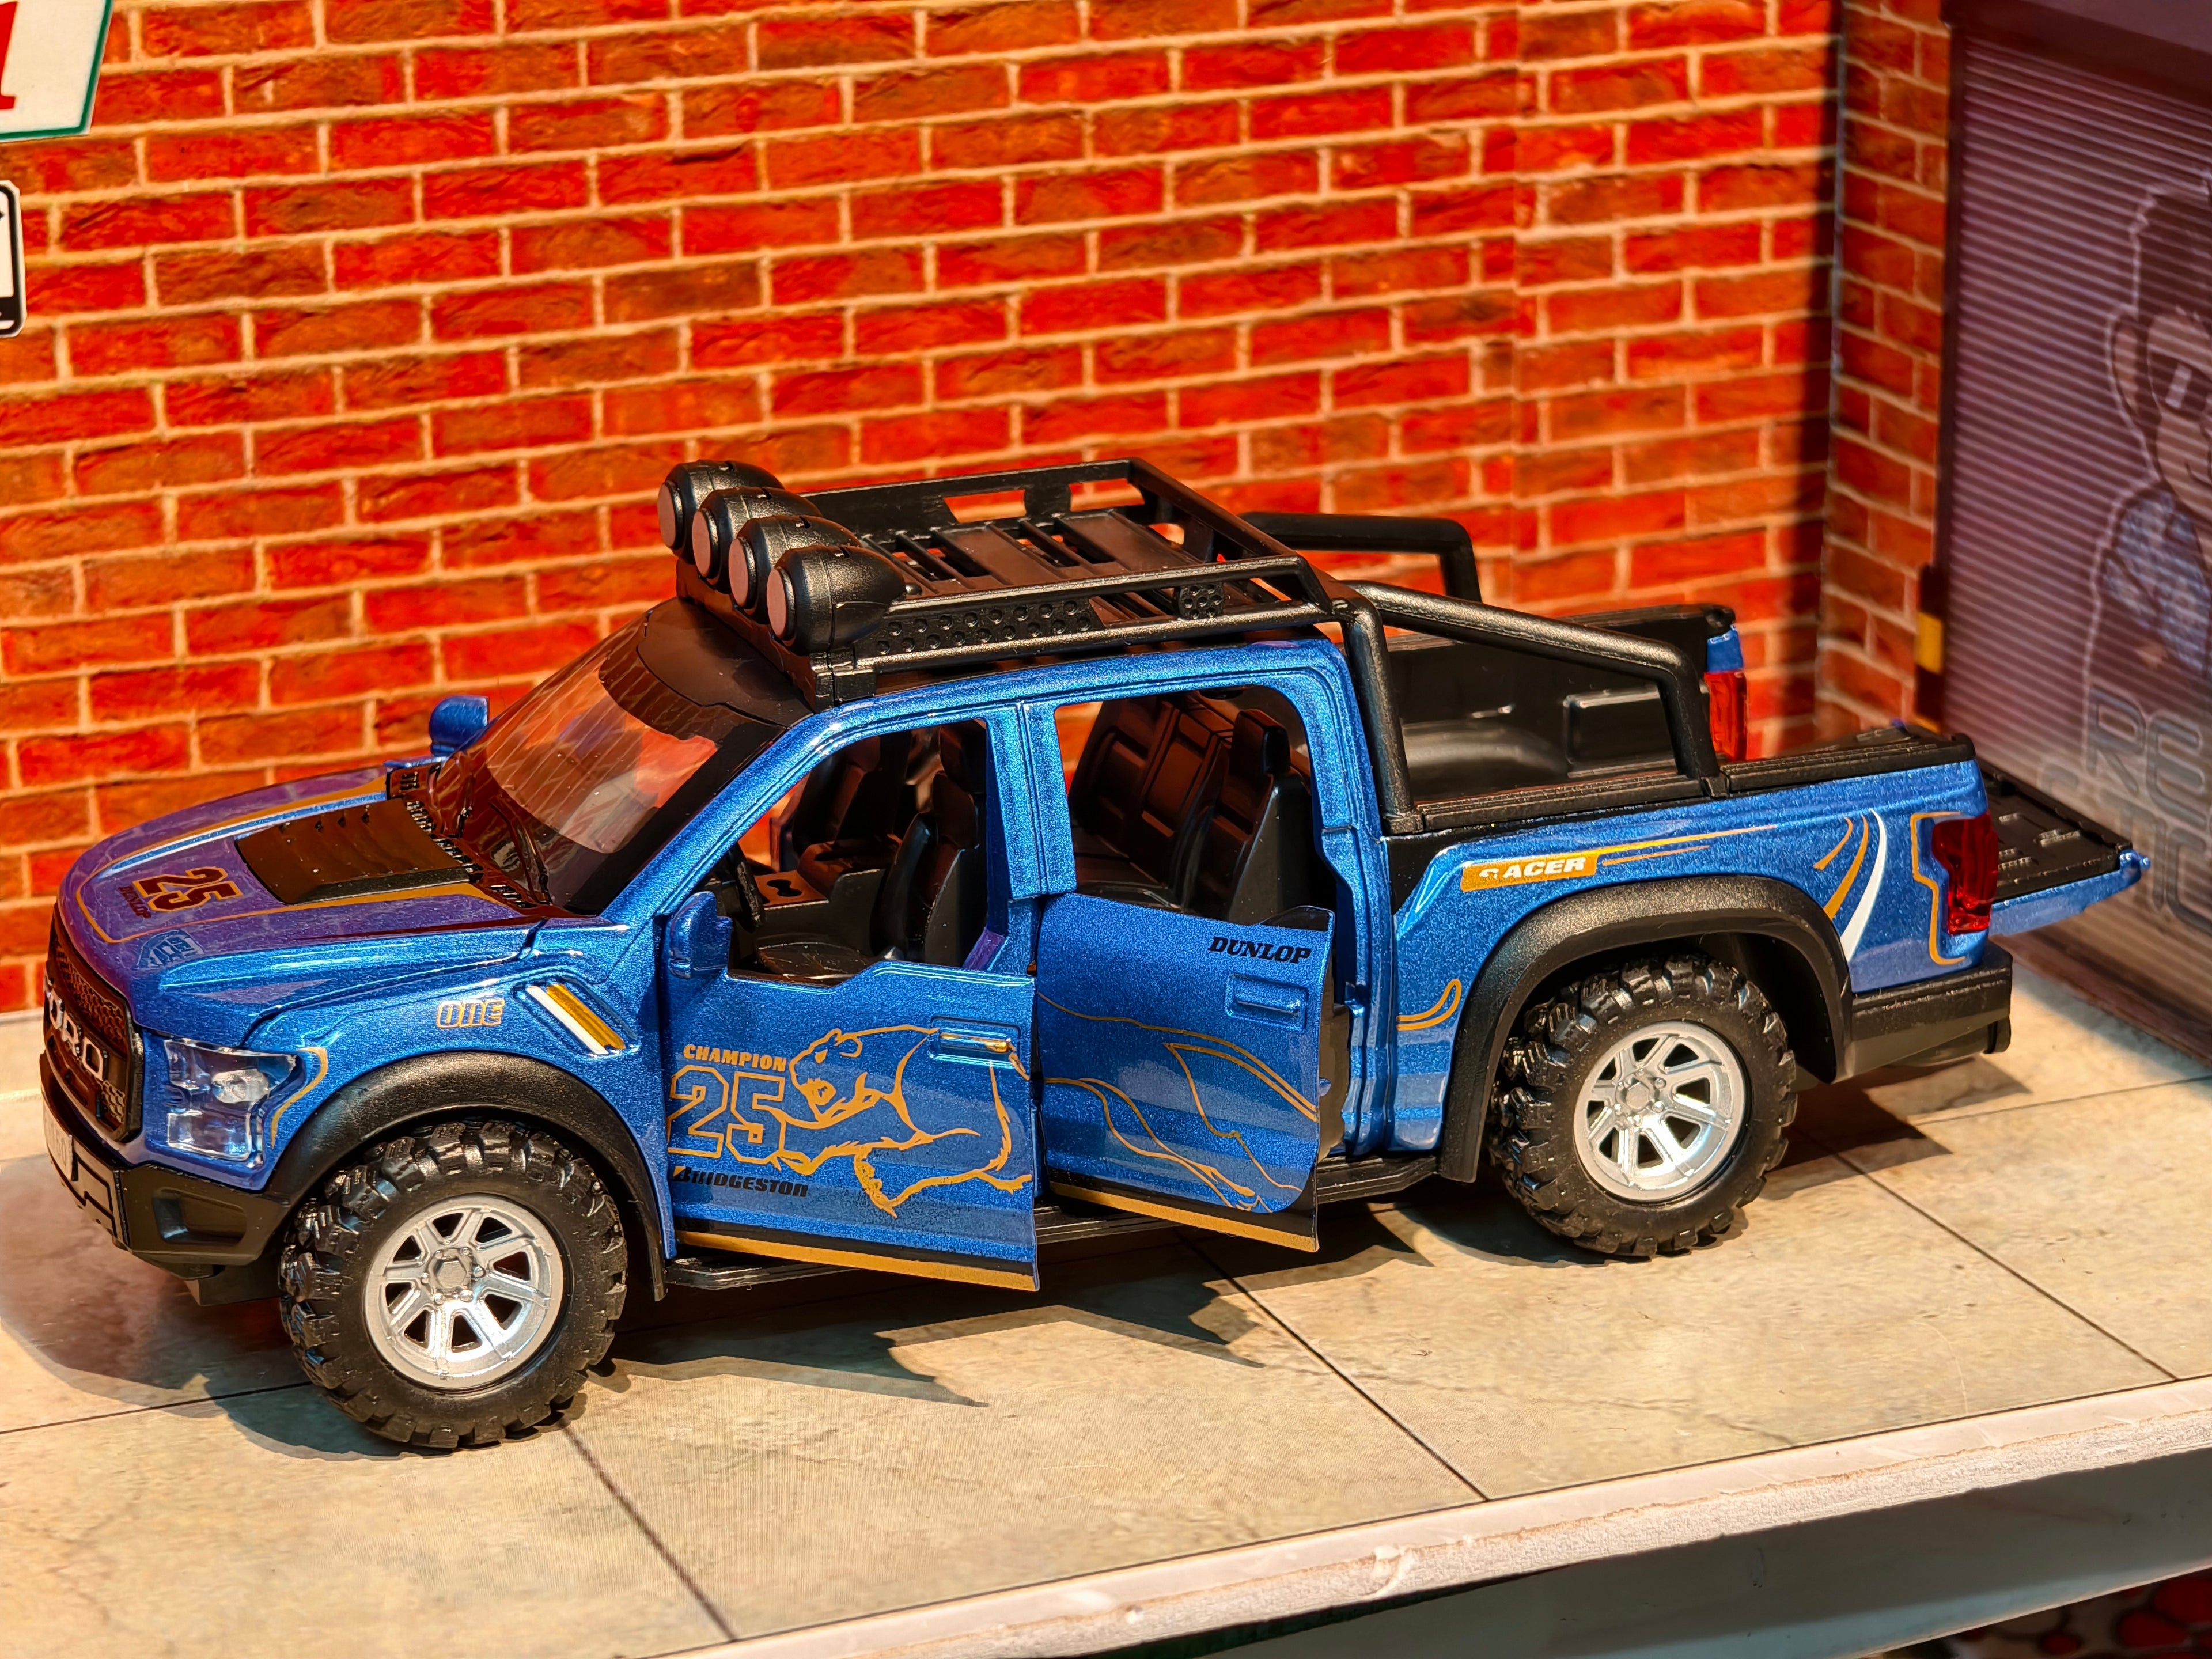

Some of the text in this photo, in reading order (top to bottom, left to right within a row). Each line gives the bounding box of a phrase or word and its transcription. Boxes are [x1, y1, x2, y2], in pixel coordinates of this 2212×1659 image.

[132, 866, 244, 912] 25
[1207, 936, 1312, 964] DUNLOP
[45, 975, 108, 1082] ORD
[683, 1043, 787, 1073] CHAMPION
[667, 1065, 786, 1165] 25
